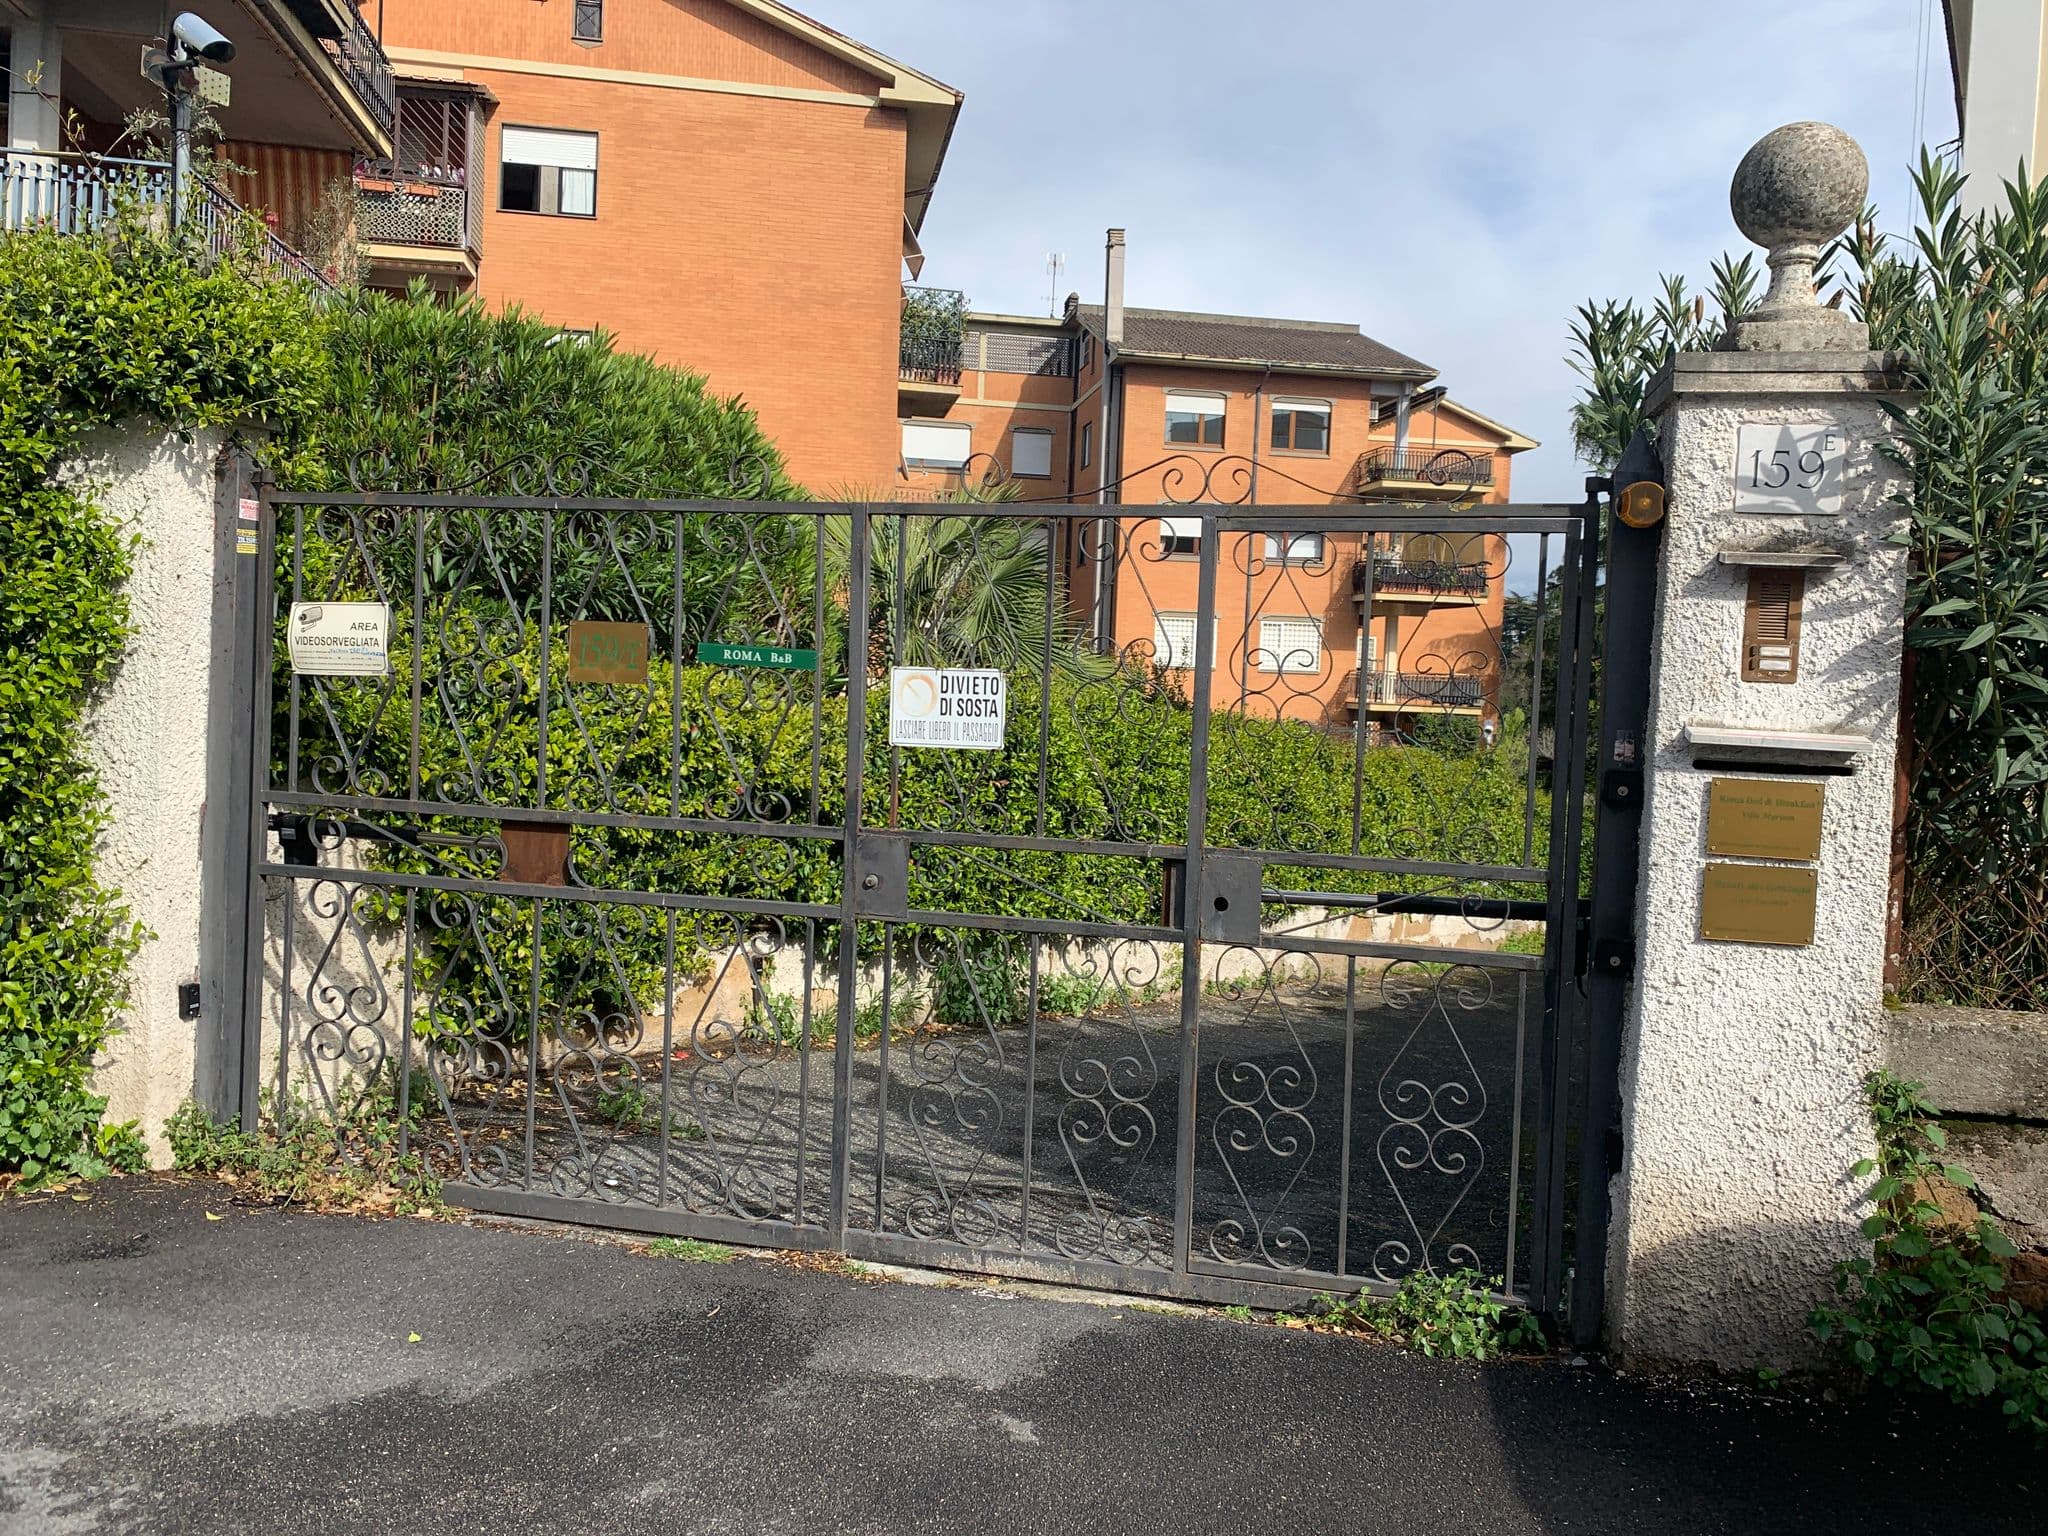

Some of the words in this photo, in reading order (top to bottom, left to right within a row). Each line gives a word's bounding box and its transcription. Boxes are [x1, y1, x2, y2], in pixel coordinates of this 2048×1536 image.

[350, 622, 378, 631] AREA
[295, 636, 380, 647] VIDEOSORVEGLIATA
[723, 650, 761, 661] ROMA
[941, 675, 999, 695] DIVIETO
[940, 698, 952, 716] DI
[956, 698, 998, 718] SOSTA
[895, 720, 926, 739] LASCIARE
[929, 721, 951, 740] LIBERO
[954, 722, 960, 740] IL
[963, 722, 999, 742] PASSAGGIO
